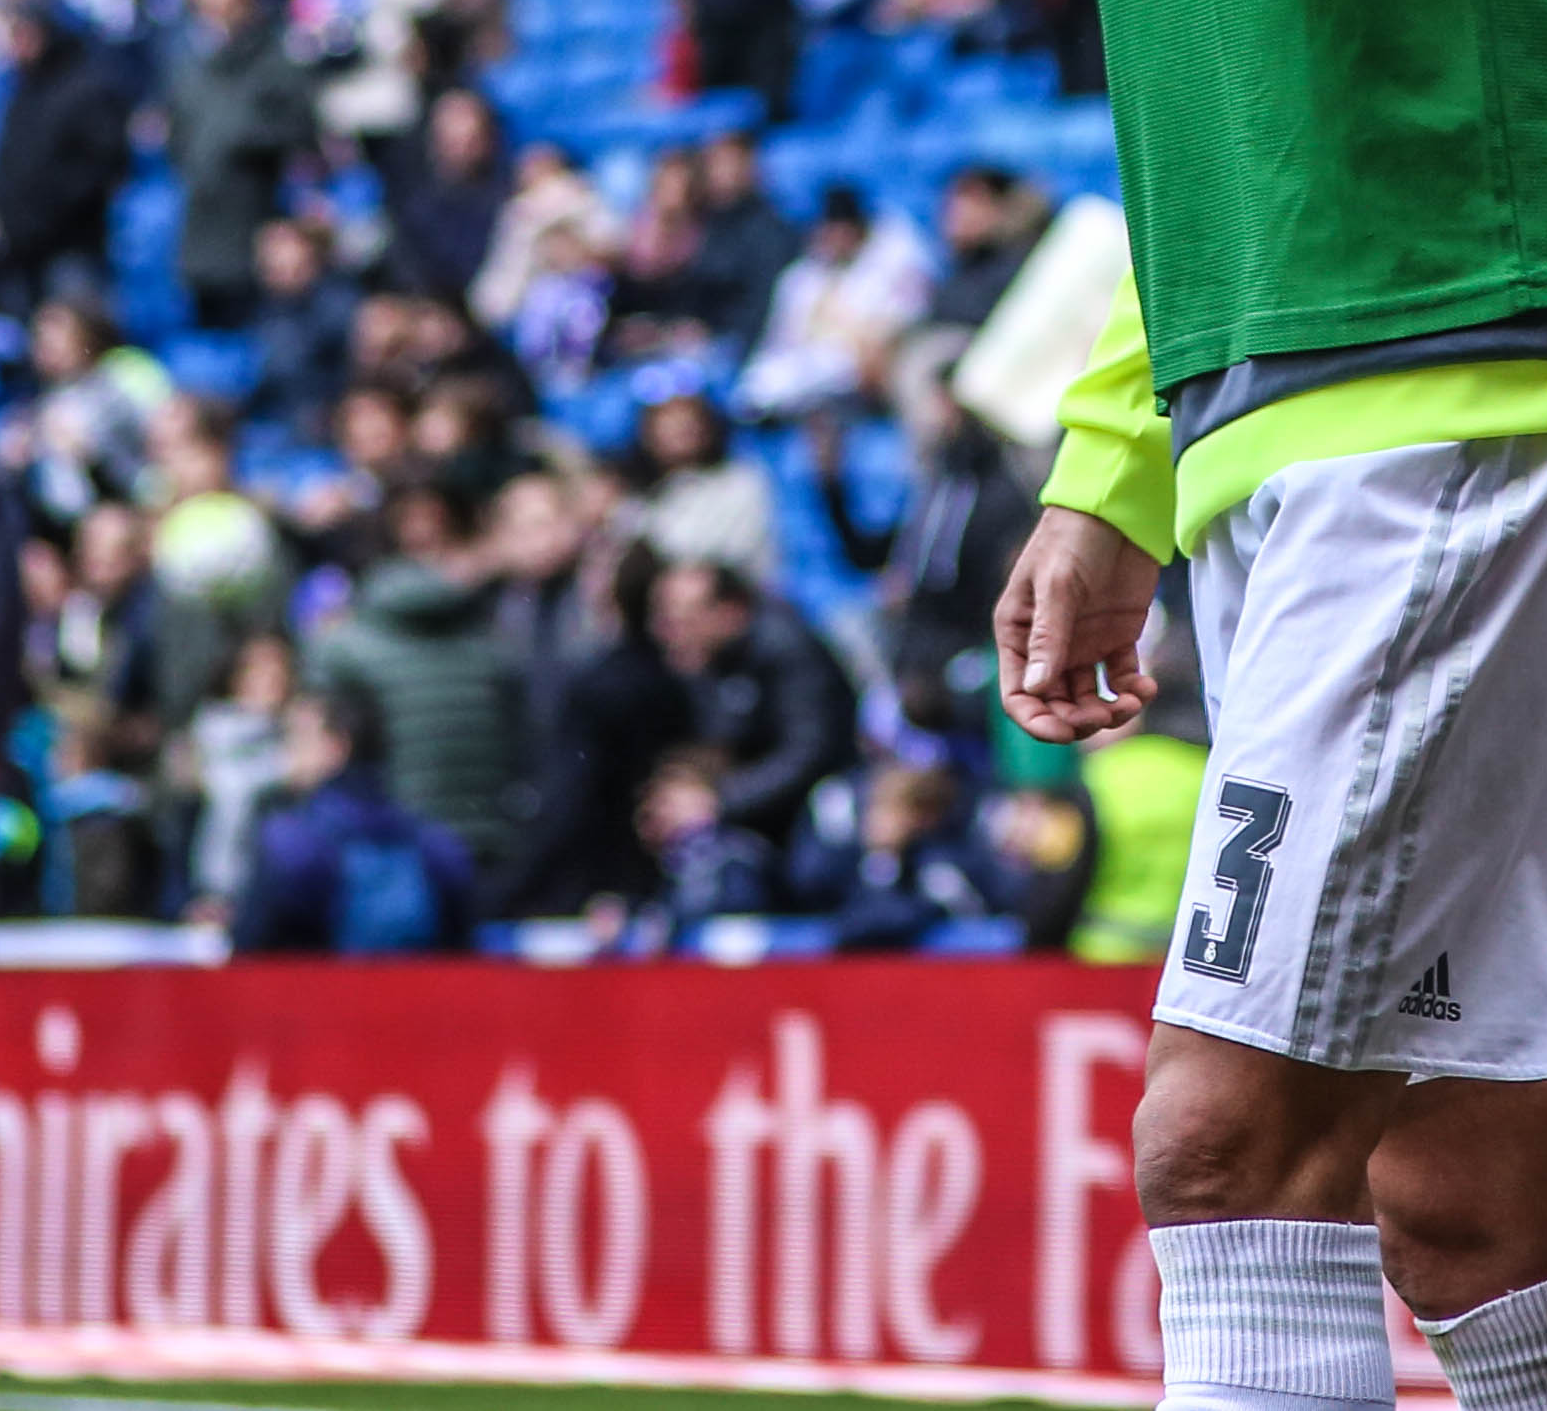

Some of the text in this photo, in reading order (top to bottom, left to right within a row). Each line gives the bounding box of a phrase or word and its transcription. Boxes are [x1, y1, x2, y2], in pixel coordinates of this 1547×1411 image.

[1183, 773, 1294, 987] 3
[1397, 990, 1462, 1023] adidas
[478, 1051, 652, 1346] to
[704, 1007, 983, 1364] the
